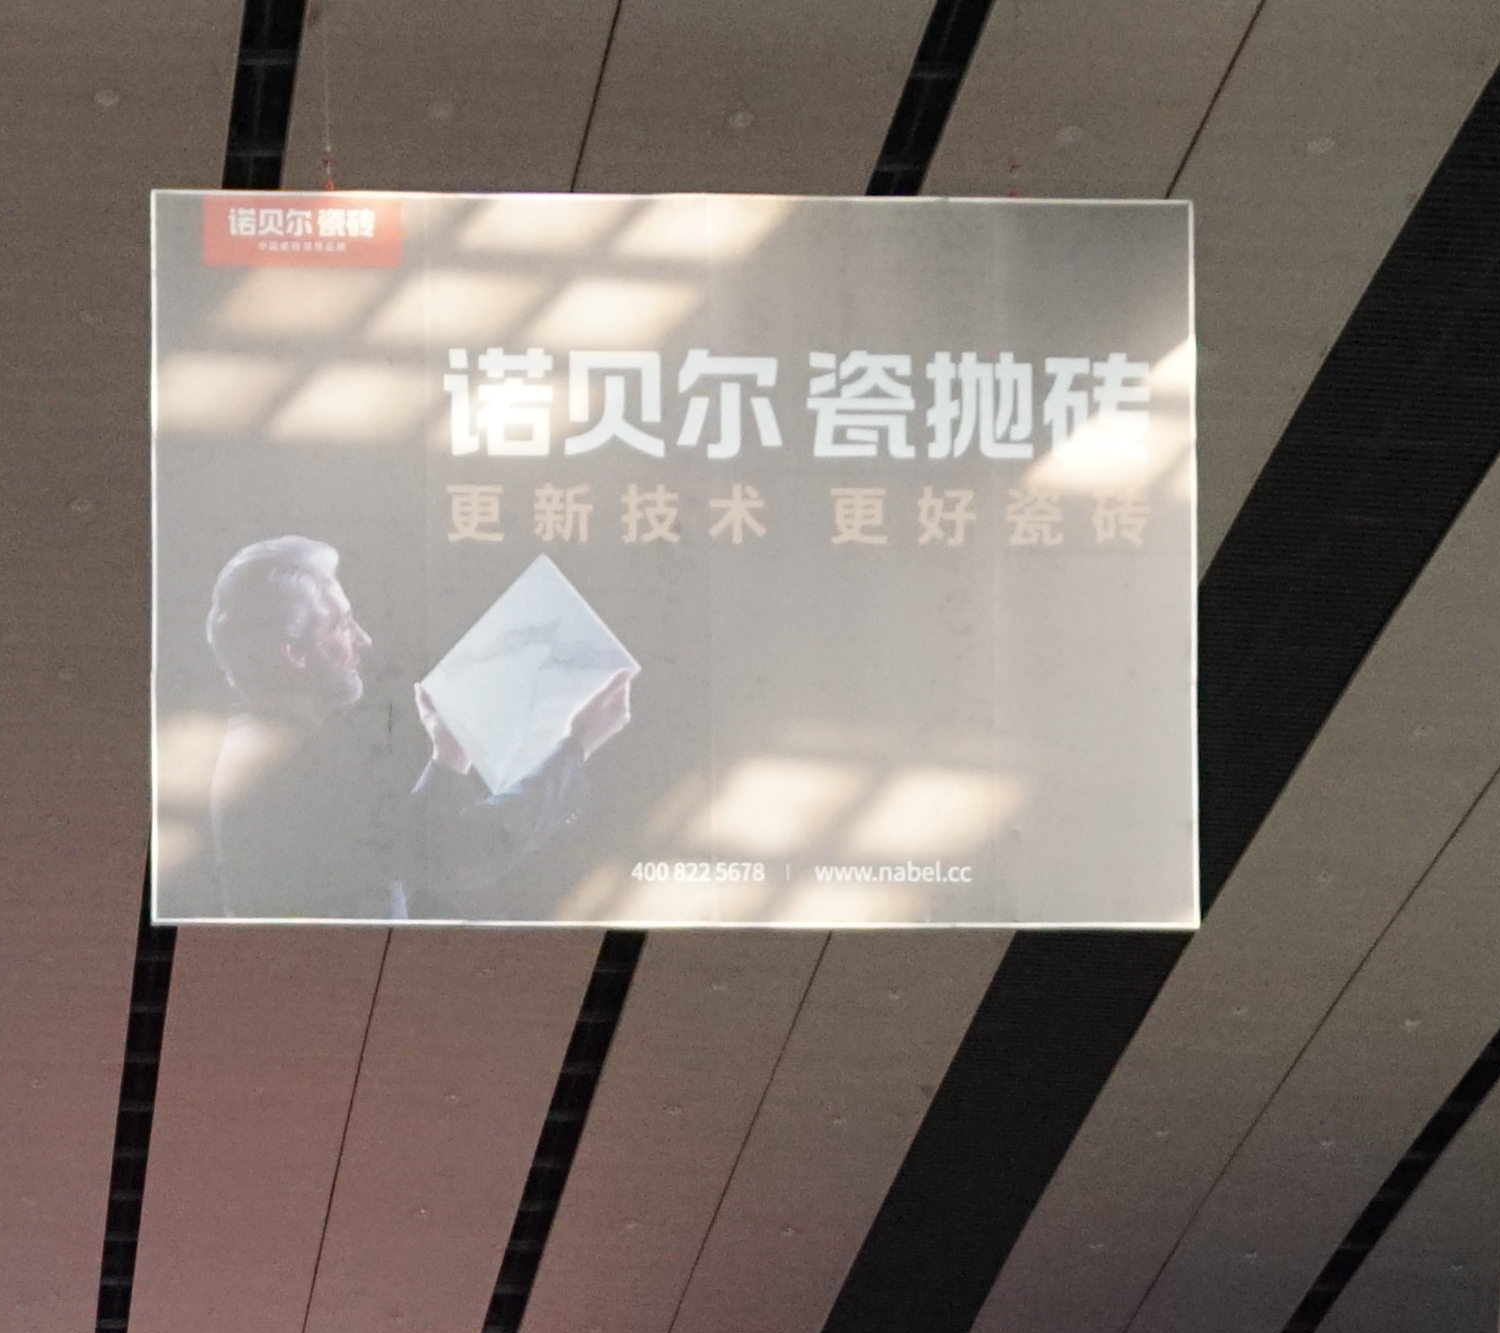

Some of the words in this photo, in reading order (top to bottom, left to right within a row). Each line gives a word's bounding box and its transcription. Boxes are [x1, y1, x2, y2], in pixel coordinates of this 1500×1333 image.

[228, 208, 313, 236] 诺贝尔
[317, 208, 376, 237] 瓷砖
[443, 348, 784, 460] 诺贝尔
[805, 349, 1154, 460] 瓷抛砖
[446, 482, 768, 545] 更新技术
[829, 484, 1154, 546] 更好瓷砖
[631, 862, 669, 883] 400
[672, 862, 710, 883] 822
[714, 862, 766, 883] 5678
[814, 862, 972, 885] www.nabel.cc
